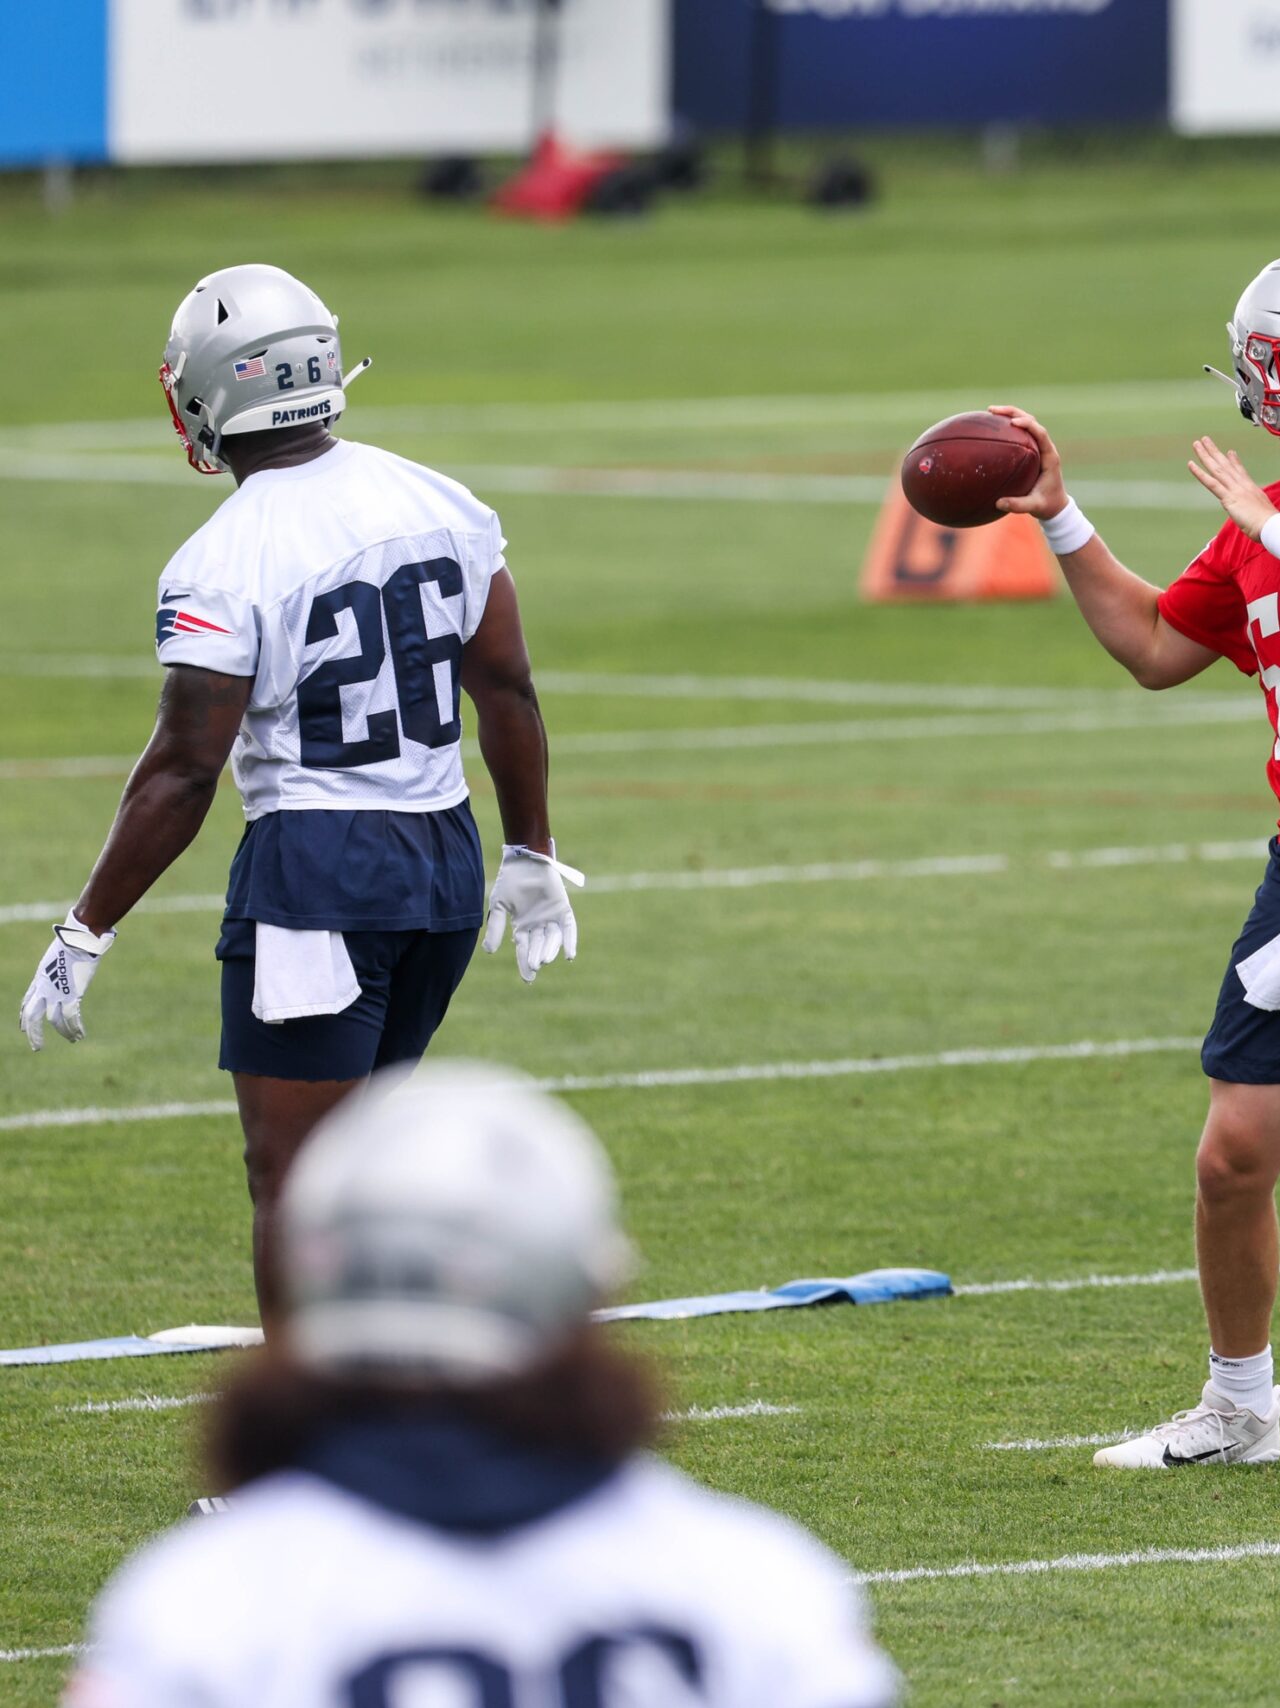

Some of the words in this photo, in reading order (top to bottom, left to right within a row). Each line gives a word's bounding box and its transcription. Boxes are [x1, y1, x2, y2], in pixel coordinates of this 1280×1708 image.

[272, 400, 331, 426] PATRIOTS
[297, 556, 464, 768] 26
[58, 950, 71, 995] adidas
